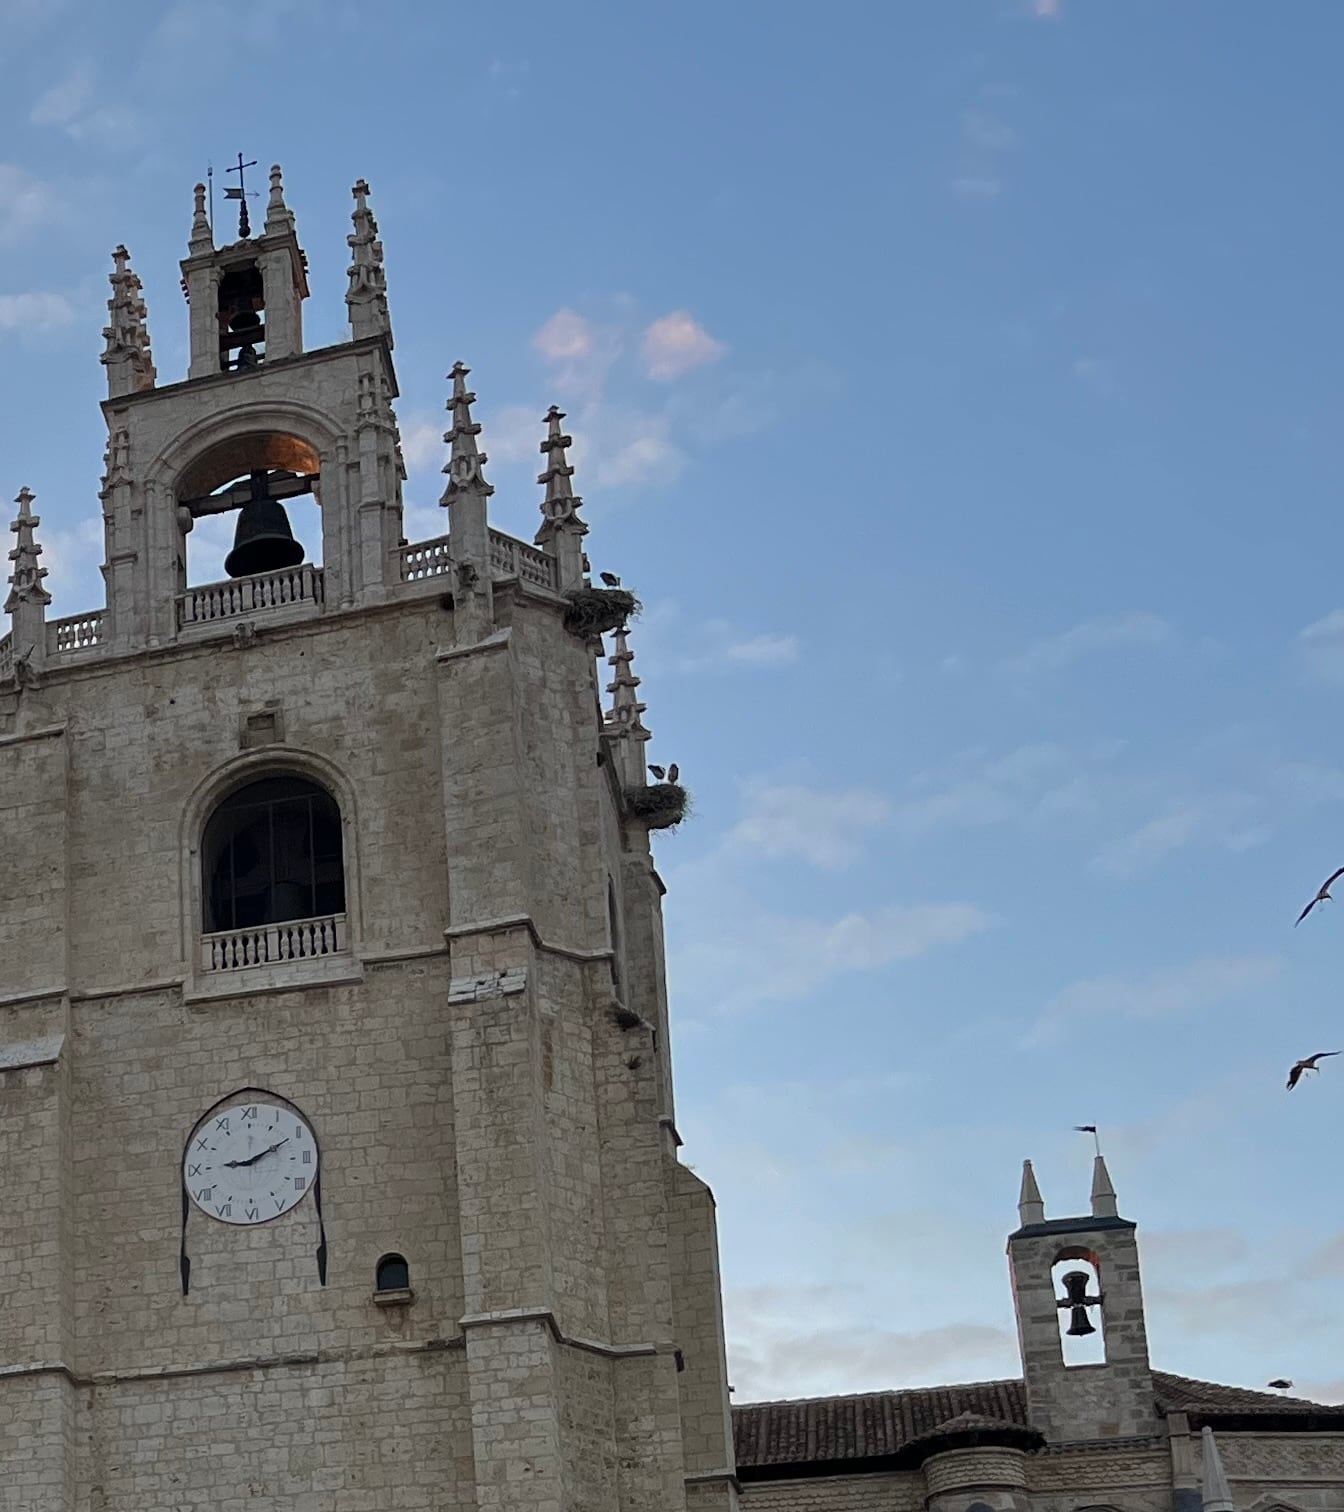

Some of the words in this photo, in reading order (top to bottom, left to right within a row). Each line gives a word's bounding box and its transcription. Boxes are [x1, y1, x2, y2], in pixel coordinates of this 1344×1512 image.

[241, 1107, 257, 1120] XII
[216, 1118, 229, 1131] XI
[197, 1138, 208, 1151] X
[303, 1151, 311, 1163] III
[188, 1163, 202, 1177] IX
[193, 1188, 212, 1201] VIII
[215, 1204, 231, 1217] VII
[274, 1200, 285, 1212] V
[245, 1208, 259, 1220] VI
